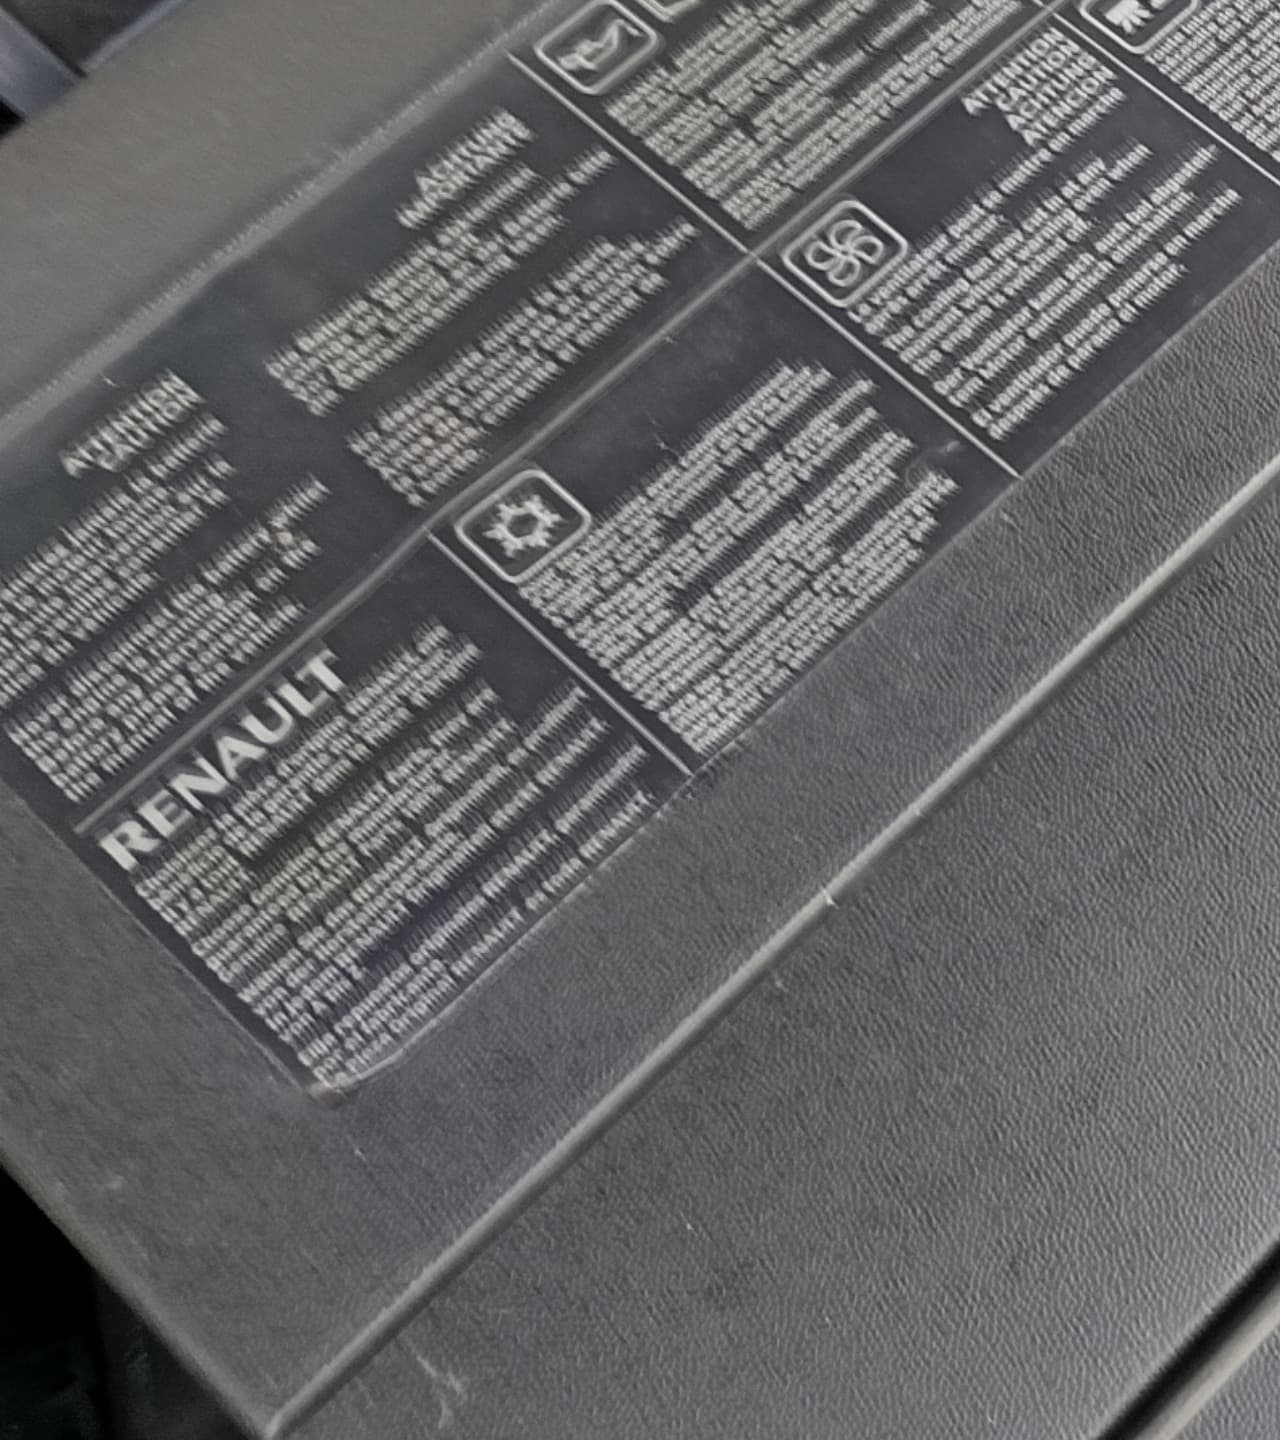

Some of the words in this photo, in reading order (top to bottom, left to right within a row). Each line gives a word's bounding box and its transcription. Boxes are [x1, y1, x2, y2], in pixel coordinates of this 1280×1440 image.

[957, 26, 1066, 116] ATTENTION
[992, 38, 1084, 114] CAUTION
[1001, 50, 1101, 132] ACHTUNG
[407, 106, 519, 195] ACHTUNG
[54, 370, 188, 477] ATTENTION
[93, 385, 203, 474] CAUTION
[95, 646, 359, 873] RENAULT
